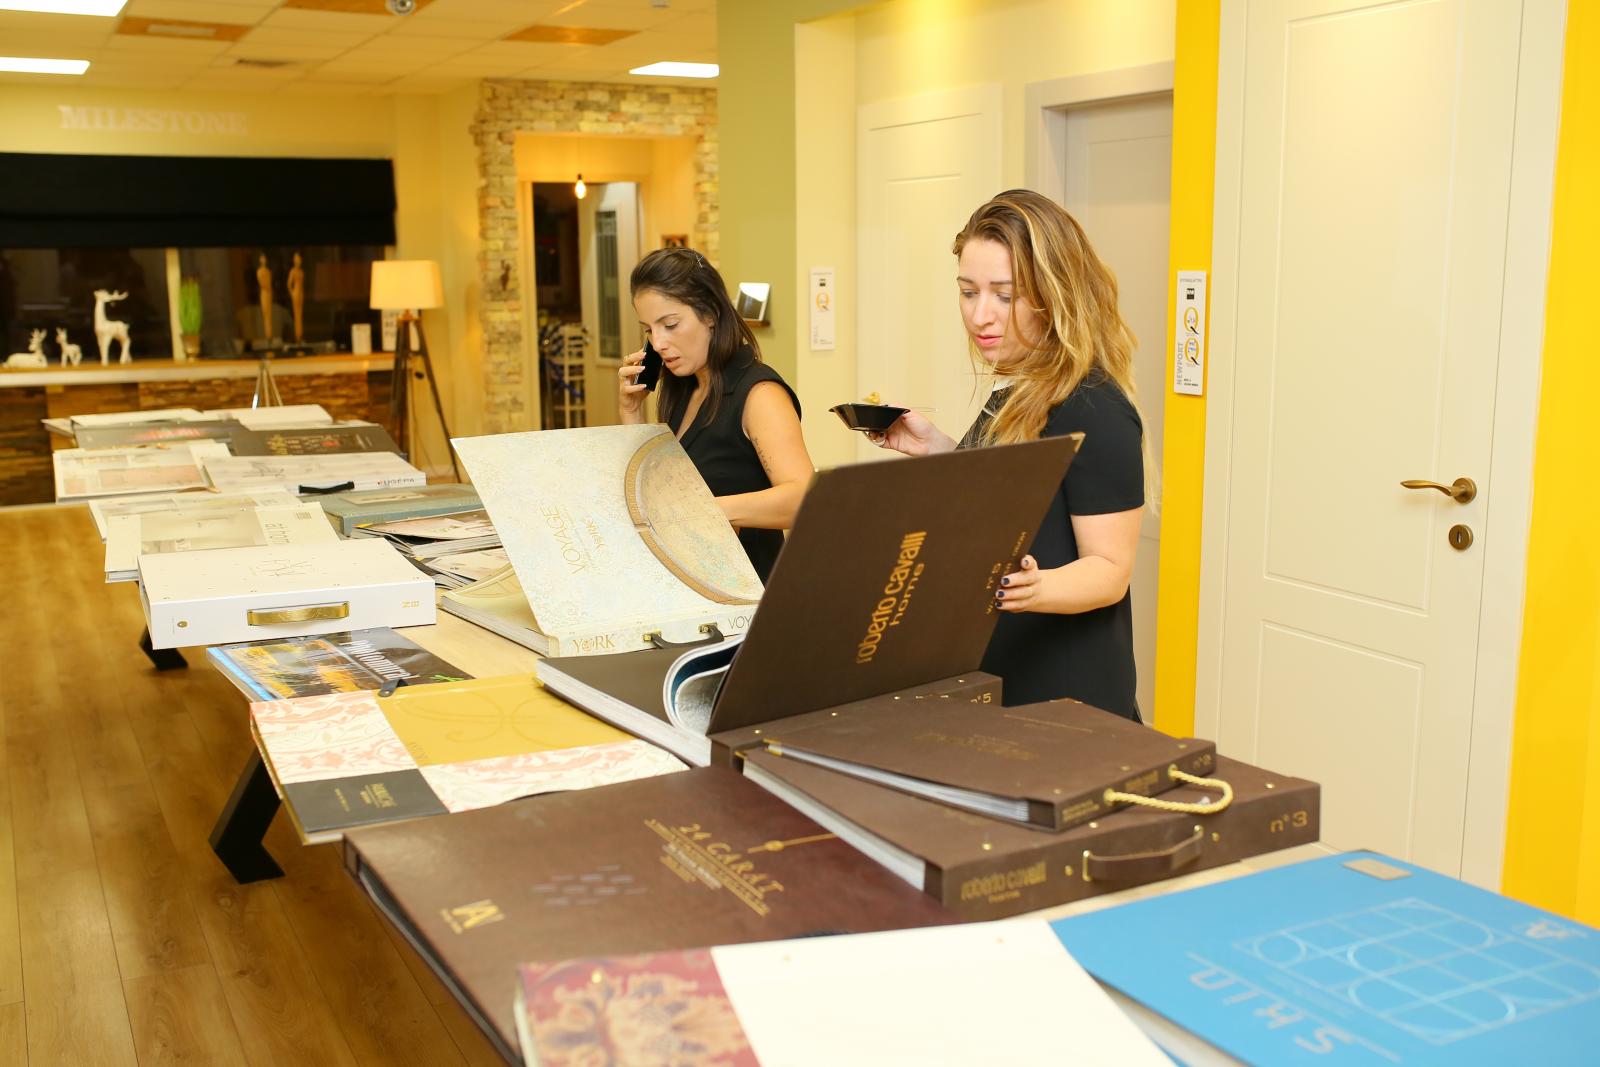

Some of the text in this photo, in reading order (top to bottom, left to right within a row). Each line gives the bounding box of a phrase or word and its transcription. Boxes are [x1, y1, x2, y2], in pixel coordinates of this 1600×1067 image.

[57, 104, 248, 135] MILESTONE
[1176, 343, 1184, 385] NEWPORT
[540, 505, 586, 575] VOYAGE
[855, 530, 928, 664] roberto cavalli
[889, 562, 925, 627] home
[728, 615, 752, 630] VOY
[706, 841, 785, 895] CARAT
